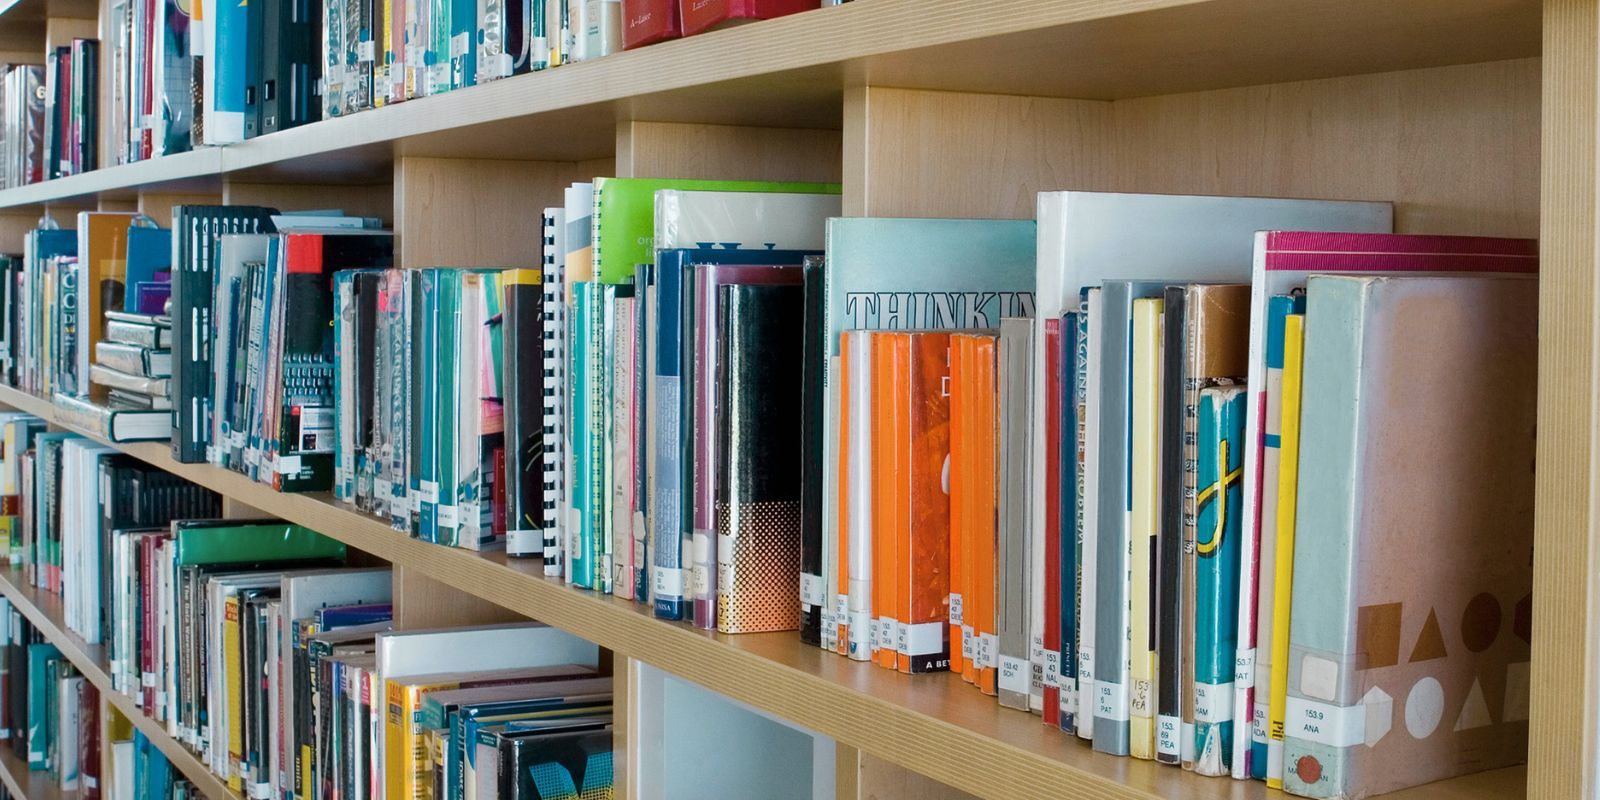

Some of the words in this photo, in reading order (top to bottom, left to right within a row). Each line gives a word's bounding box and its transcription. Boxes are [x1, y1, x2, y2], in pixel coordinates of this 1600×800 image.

[1236, 658, 1251, 666] 53.7
[1049, 664, 1056, 673] 43
[1046, 673, 1058, 683] NAL
[1134, 679, 1150, 691] 153
[1131, 699, 1146, 711] PEA
[1305, 709, 1324, 721] 153.9
[1303, 724, 1320, 735] ANA
[1160, 731, 1169, 739] 69
[1160, 740, 1175, 749] PEA
